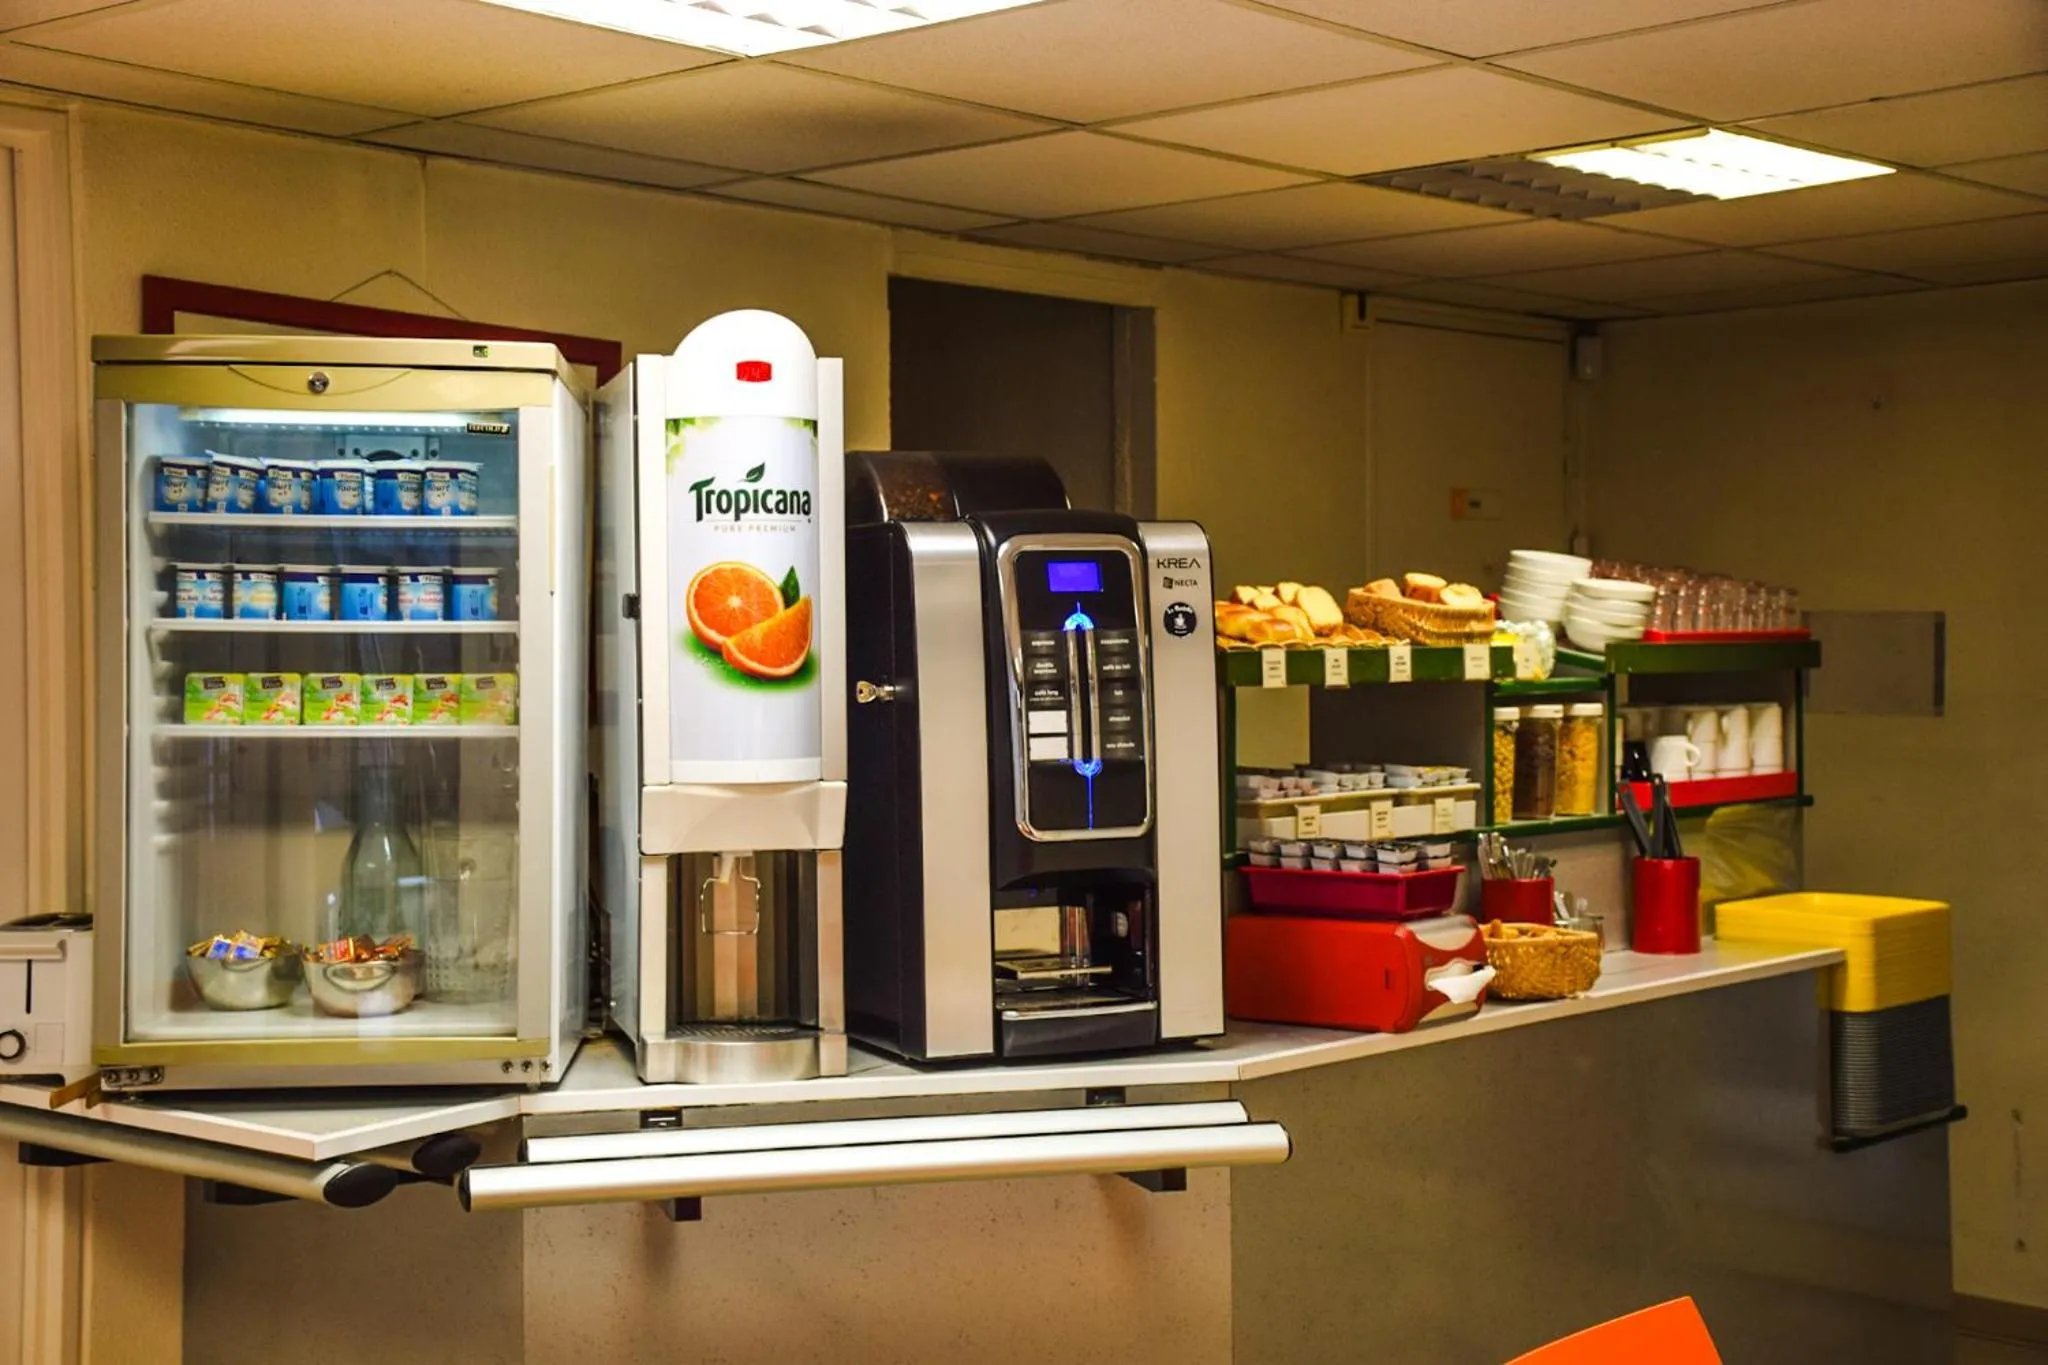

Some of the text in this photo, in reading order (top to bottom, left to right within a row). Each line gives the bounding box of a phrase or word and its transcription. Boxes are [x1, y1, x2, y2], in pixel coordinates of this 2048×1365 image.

[688, 477, 811, 522] Tropicana
[714, 525, 796, 533] PURE PREMIUM
[1156, 557, 1201, 569] KREA
[1174, 579, 1198, 587] NECTA
